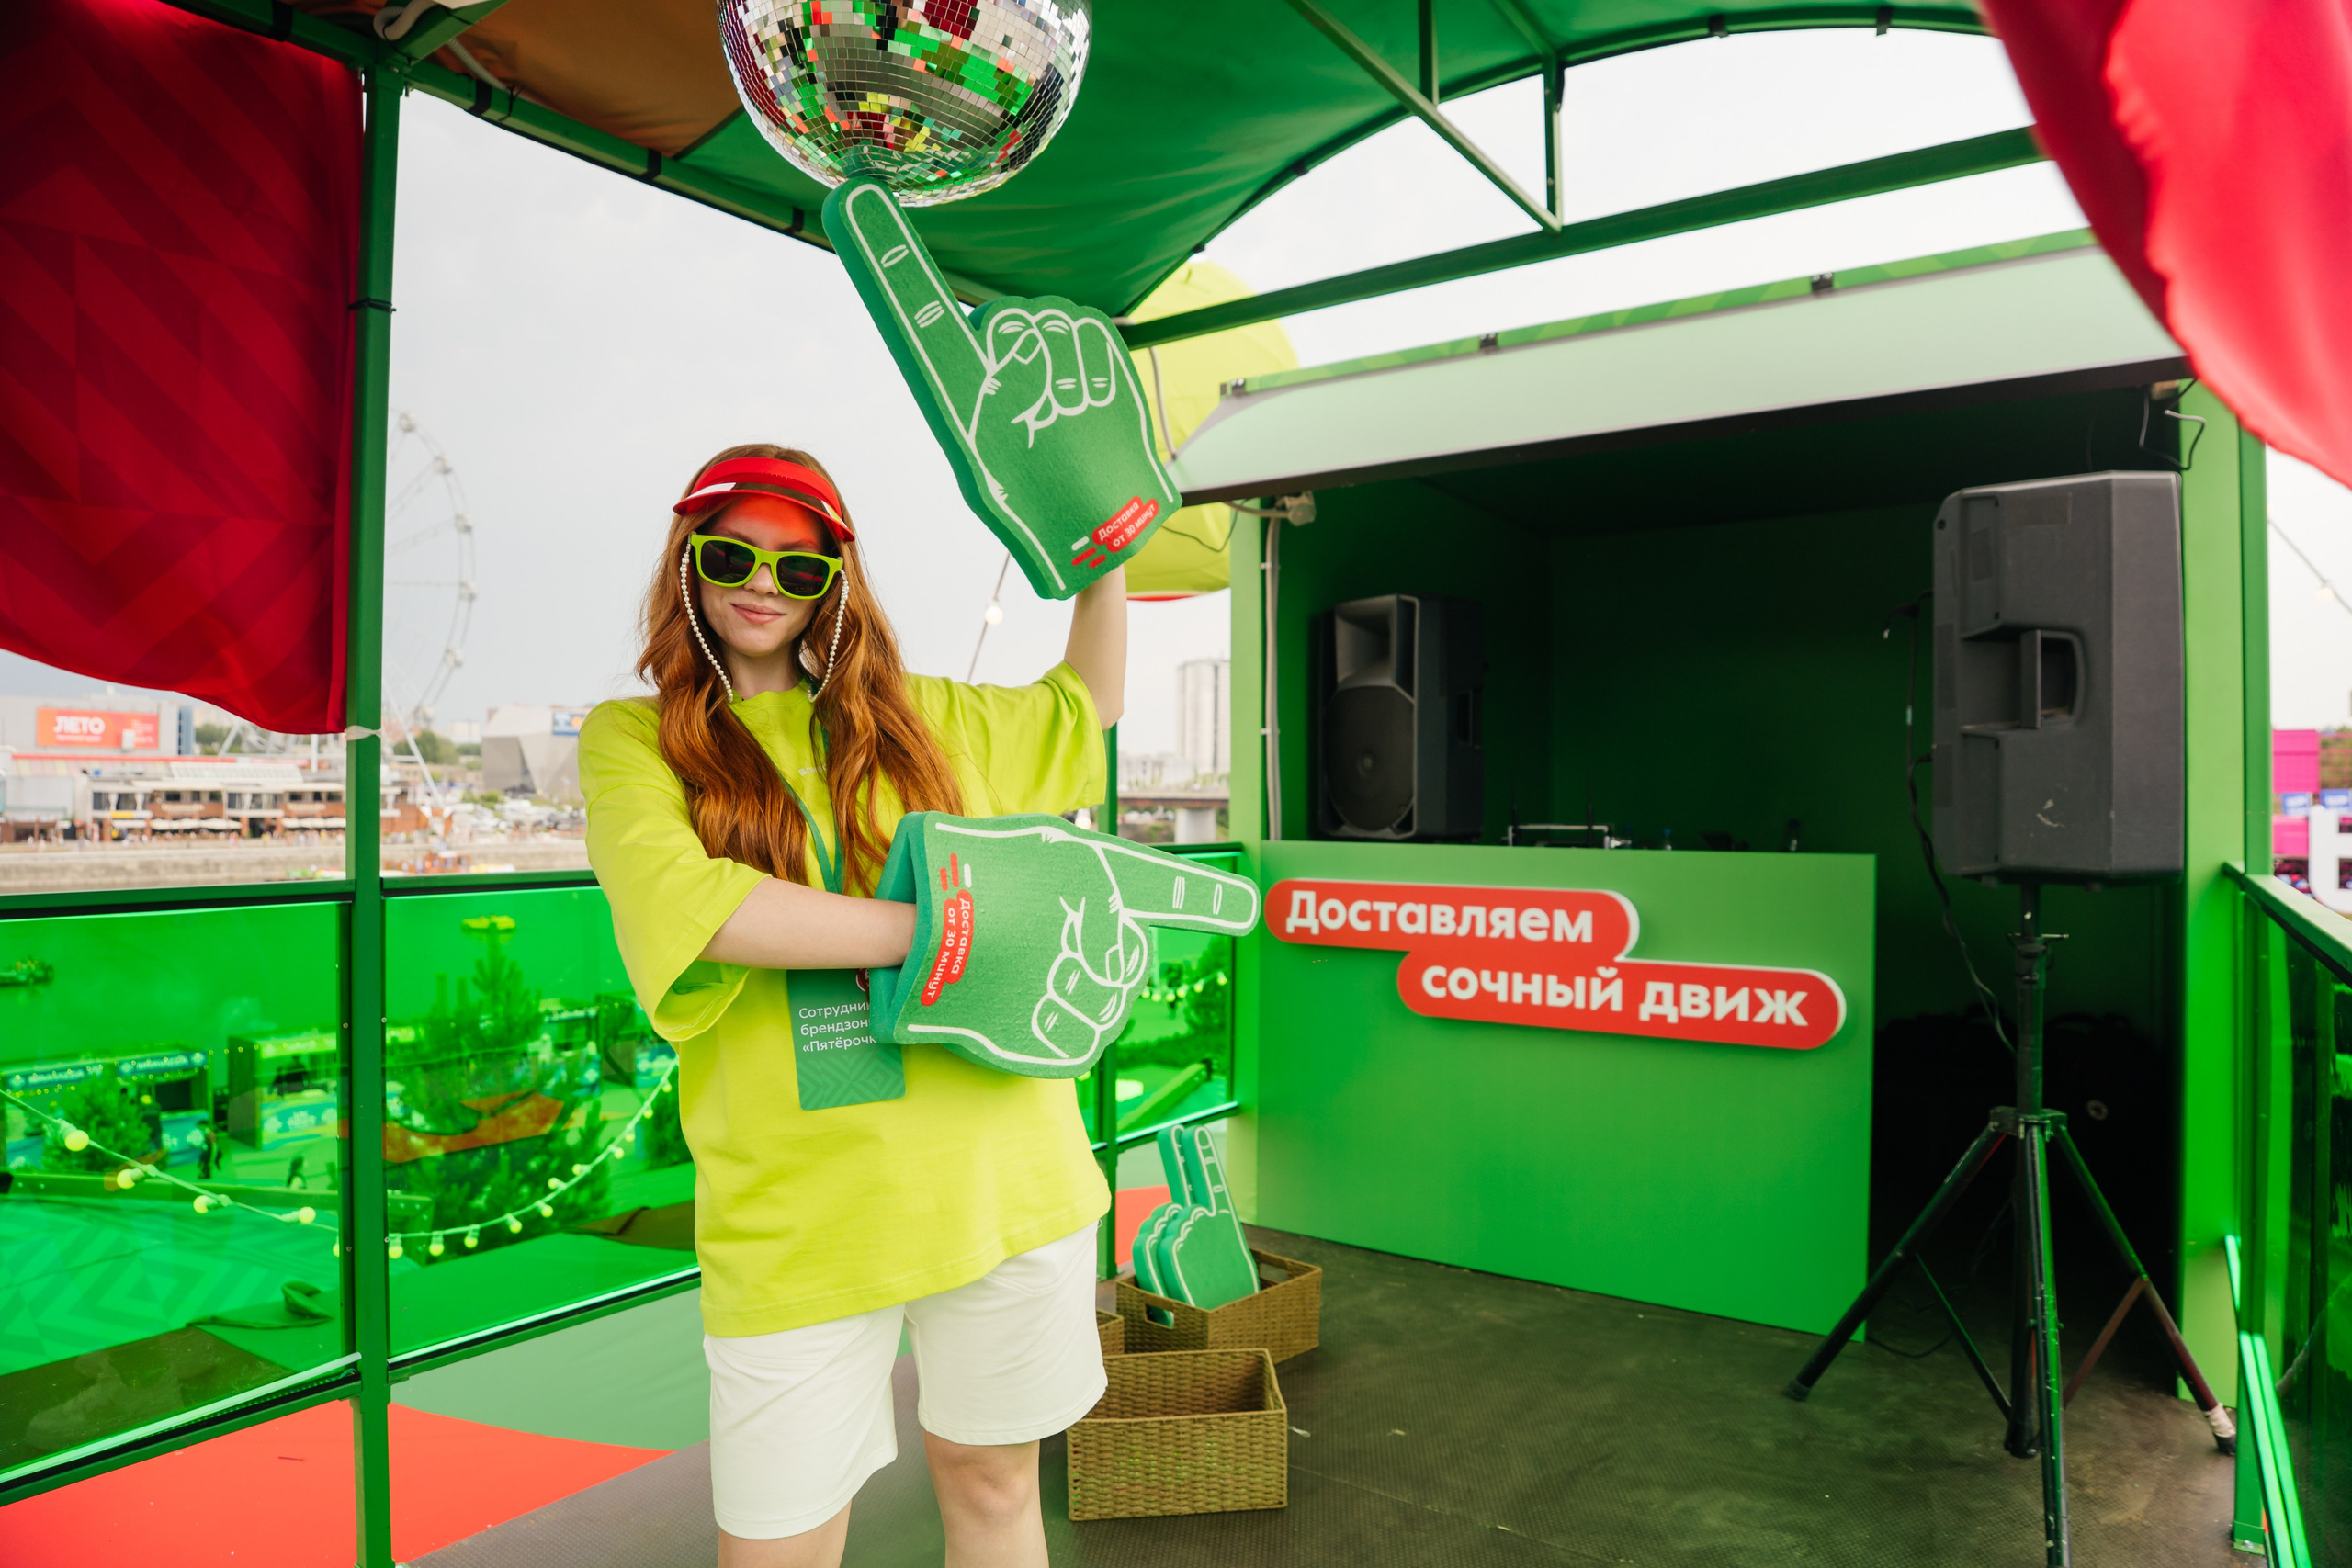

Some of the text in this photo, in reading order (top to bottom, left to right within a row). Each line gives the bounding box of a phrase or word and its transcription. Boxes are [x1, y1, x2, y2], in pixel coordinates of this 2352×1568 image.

[1098, 502, 1139, 542] Доставка
[1113, 503, 1156, 547] от 30 минут
[52, 716, 106, 735] ЛЕТО
[951, 897, 971, 975] Доставка
[1286, 889, 1594, 944] Доставляем
[927, 908, 956, 998] от 30 минут
[1420, 965, 1809, 1027] сочный движ
[800, 1019, 870, 1038] брендзон
